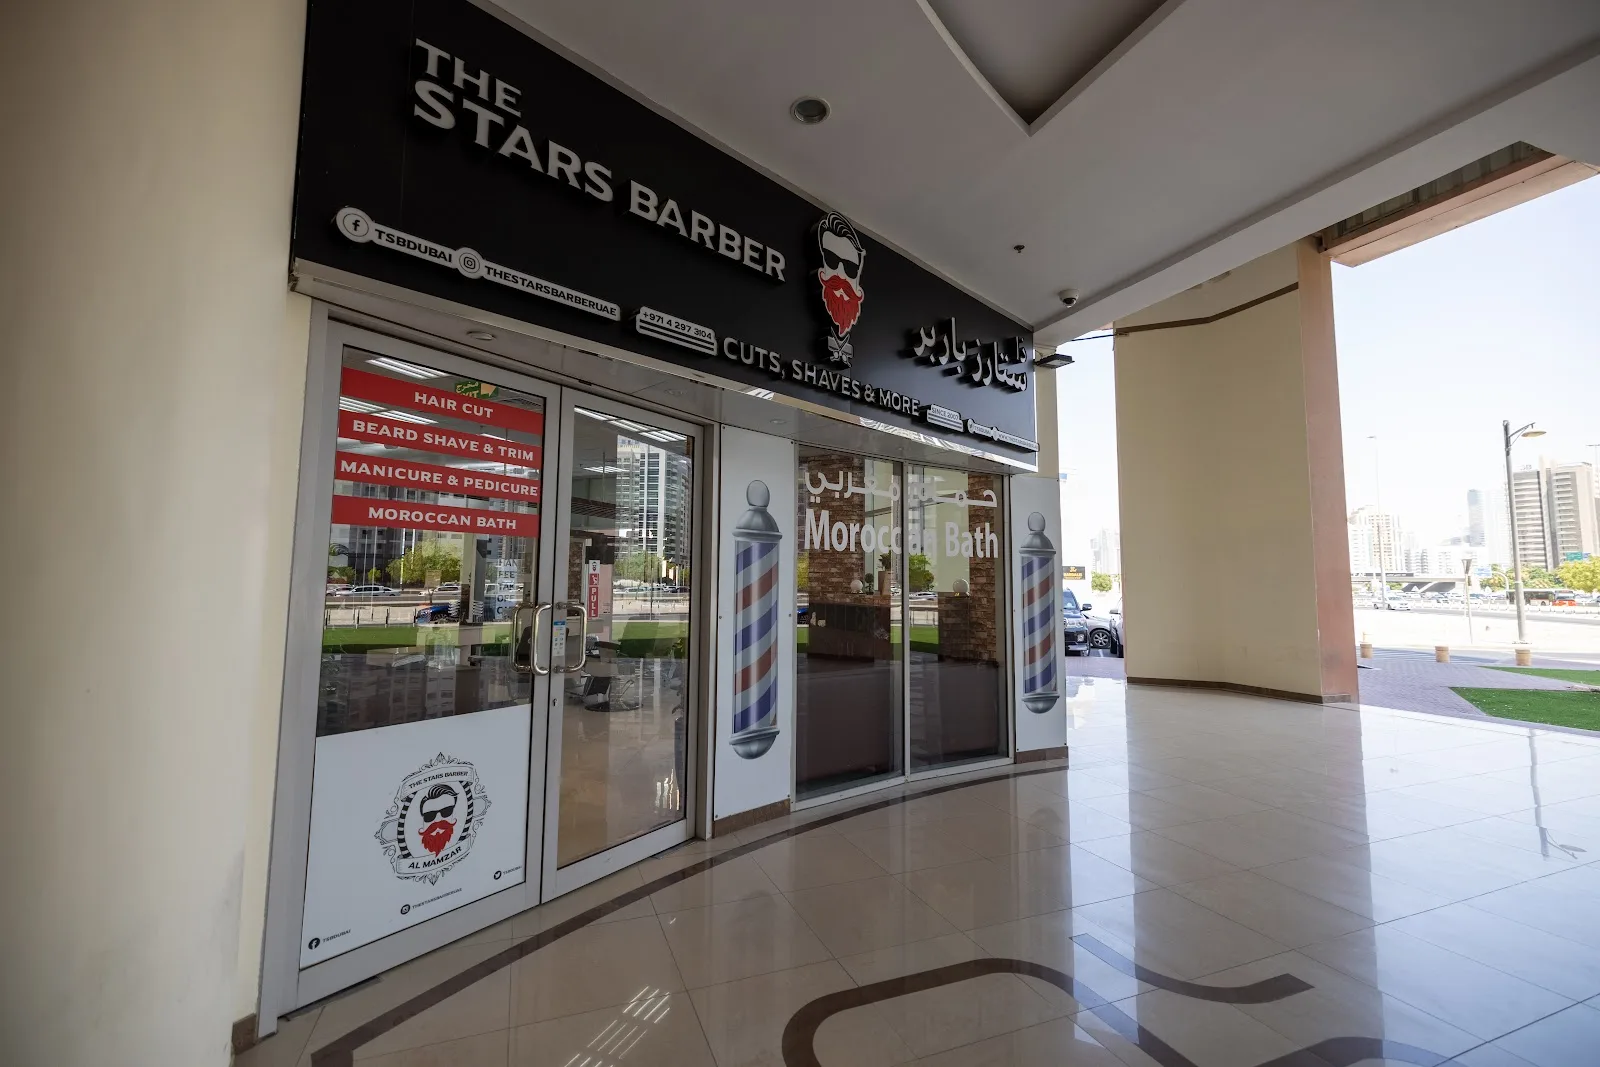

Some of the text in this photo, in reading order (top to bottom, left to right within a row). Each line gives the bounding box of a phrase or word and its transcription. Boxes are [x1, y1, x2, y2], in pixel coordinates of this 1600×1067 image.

[415, 38, 522, 118] THE
[413, 79, 786, 283] STARS BARBER
[374, 228, 617, 317] TSBDUBAI THESTARSBARBERUAE
[643, 311, 712, 340] +971 4 297 3104
[913, 317, 1028, 392] ستارز باربر
[723, 337, 920, 417] CUTS, SHAVES & MORE
[414, 391, 494, 419] HAIR CUT
[931, 407, 947, 418] SINCE
[353, 419, 534, 461] BEARD SHAVE & TRIM
[340, 460, 538, 497] MANICURE & PEDICURE
[368, 506, 517, 530] MOROCCAN BATH
[804, 508, 999, 559] Moroccan Bath
[408, 780, 422, 789] THE
[423, 773, 443, 783] STARS
[408, 846, 462, 869] AL MAMZAR
